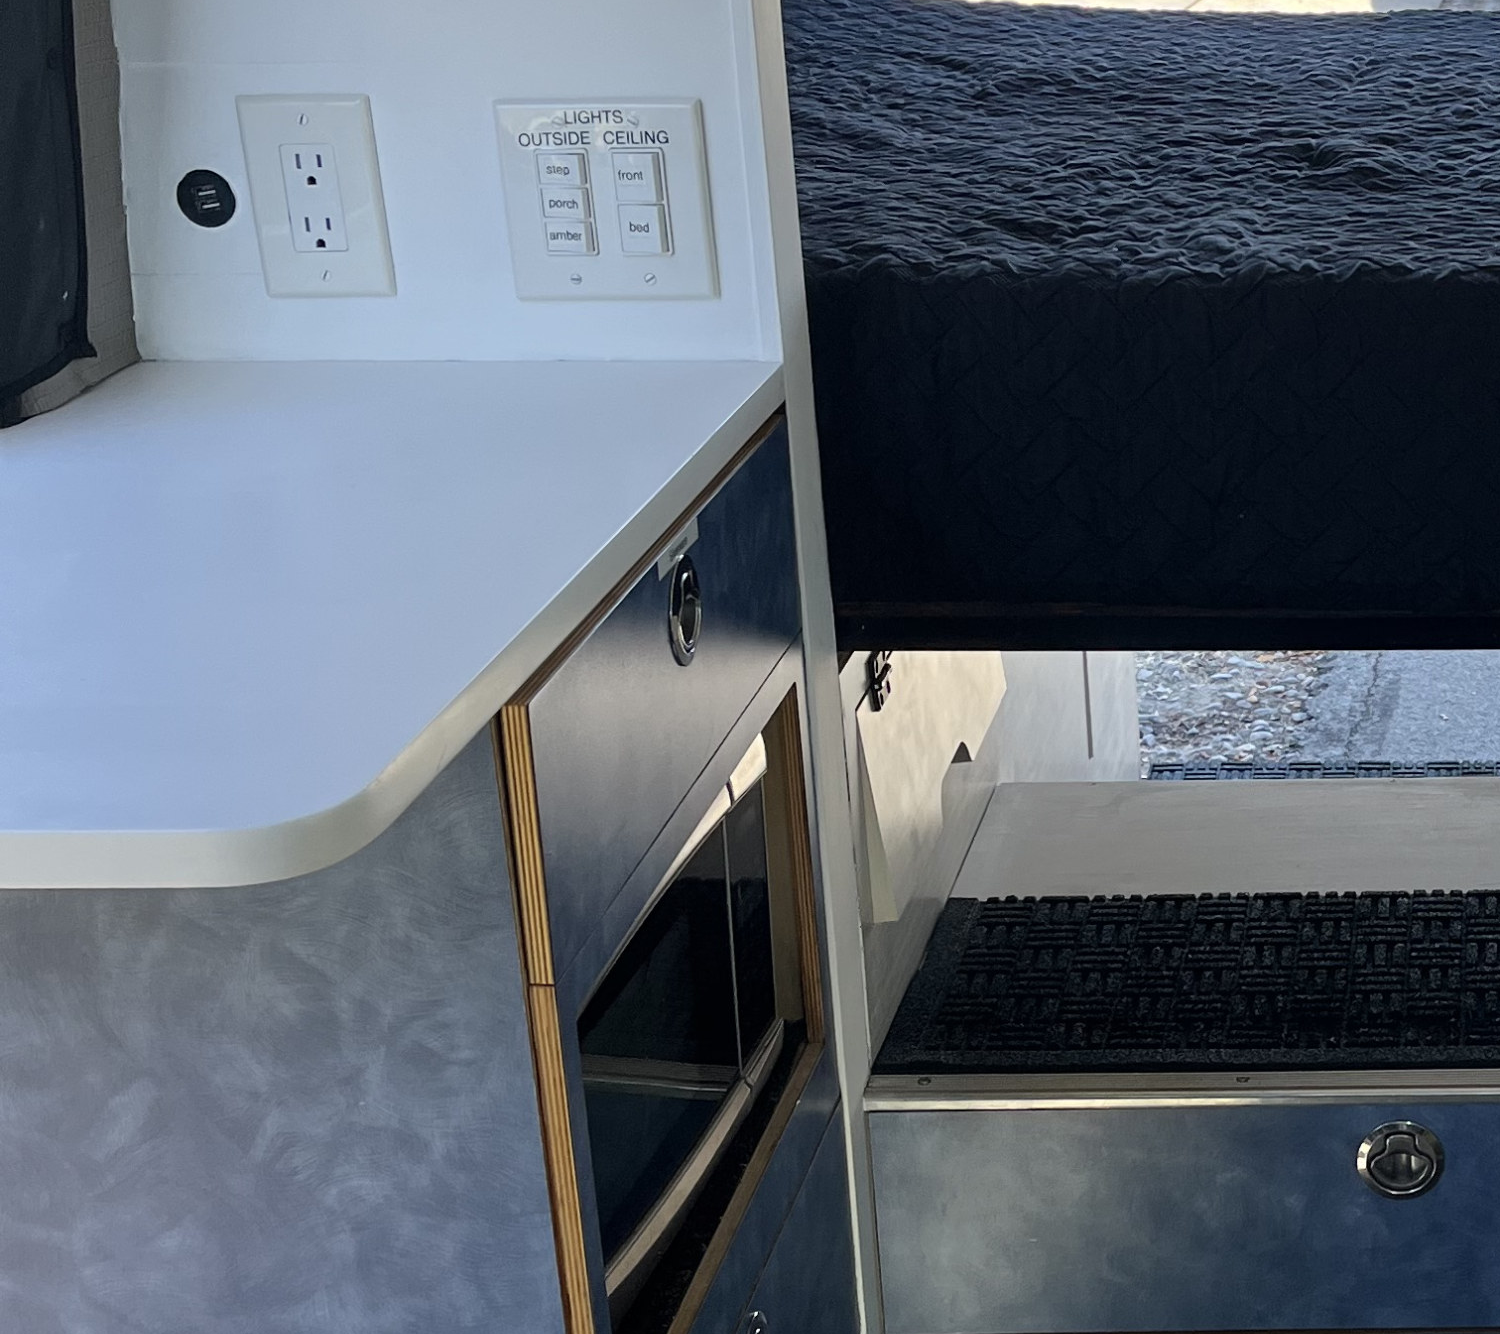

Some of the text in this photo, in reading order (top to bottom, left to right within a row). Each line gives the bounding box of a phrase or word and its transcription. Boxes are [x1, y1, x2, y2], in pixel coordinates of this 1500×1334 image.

[563, 110, 624, 125] LIGHTS
[518, 130, 670, 147] OUTSIDE CEILING
[546, 165, 570, 176] step
[618, 170, 644, 181] front
[549, 198, 579, 210] porch
[629, 222, 650, 233] bed
[550, 230, 582, 241] amber
